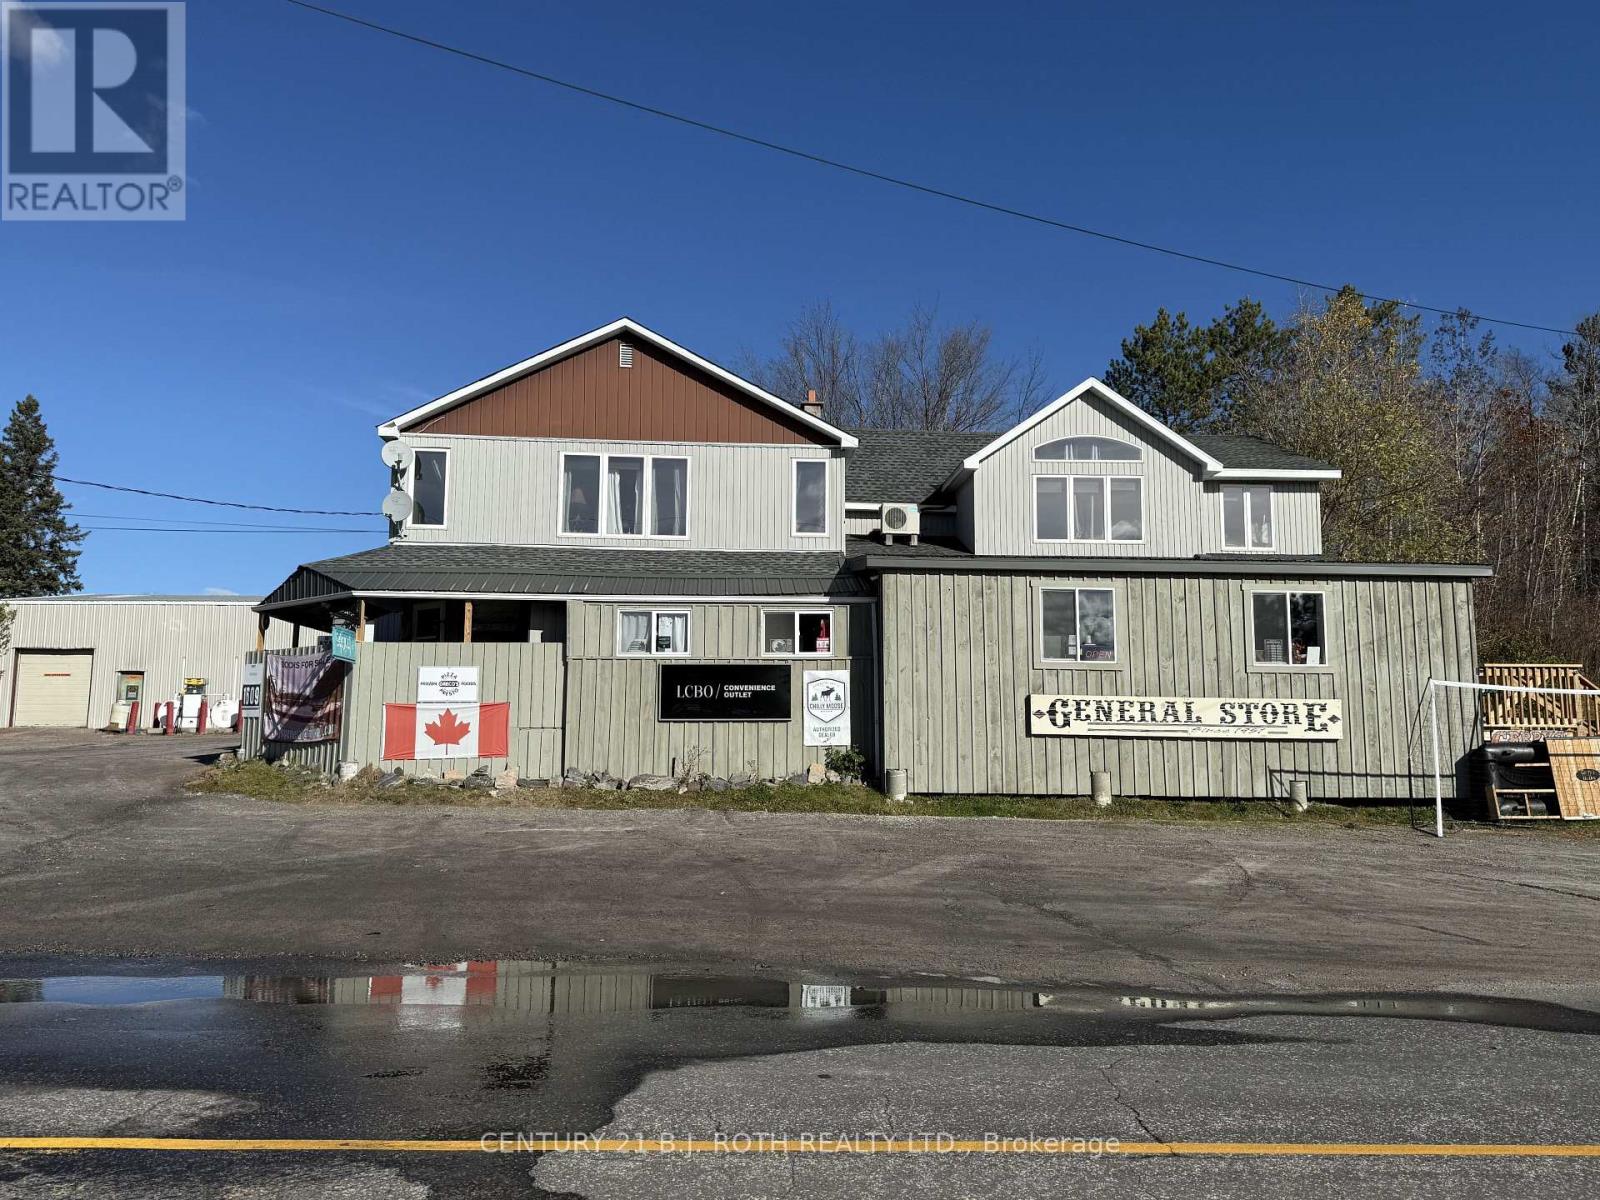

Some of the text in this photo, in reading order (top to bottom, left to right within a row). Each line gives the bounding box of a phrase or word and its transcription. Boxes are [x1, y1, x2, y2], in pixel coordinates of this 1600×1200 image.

[1086, 650, 1112, 660] OPEN
[301, 660, 313, 669] FOR
[677, 685, 714, 699] LCBO
[723, 691, 752, 699] OUTLET
[1046, 698, 1330, 732] GENERAL STORE
